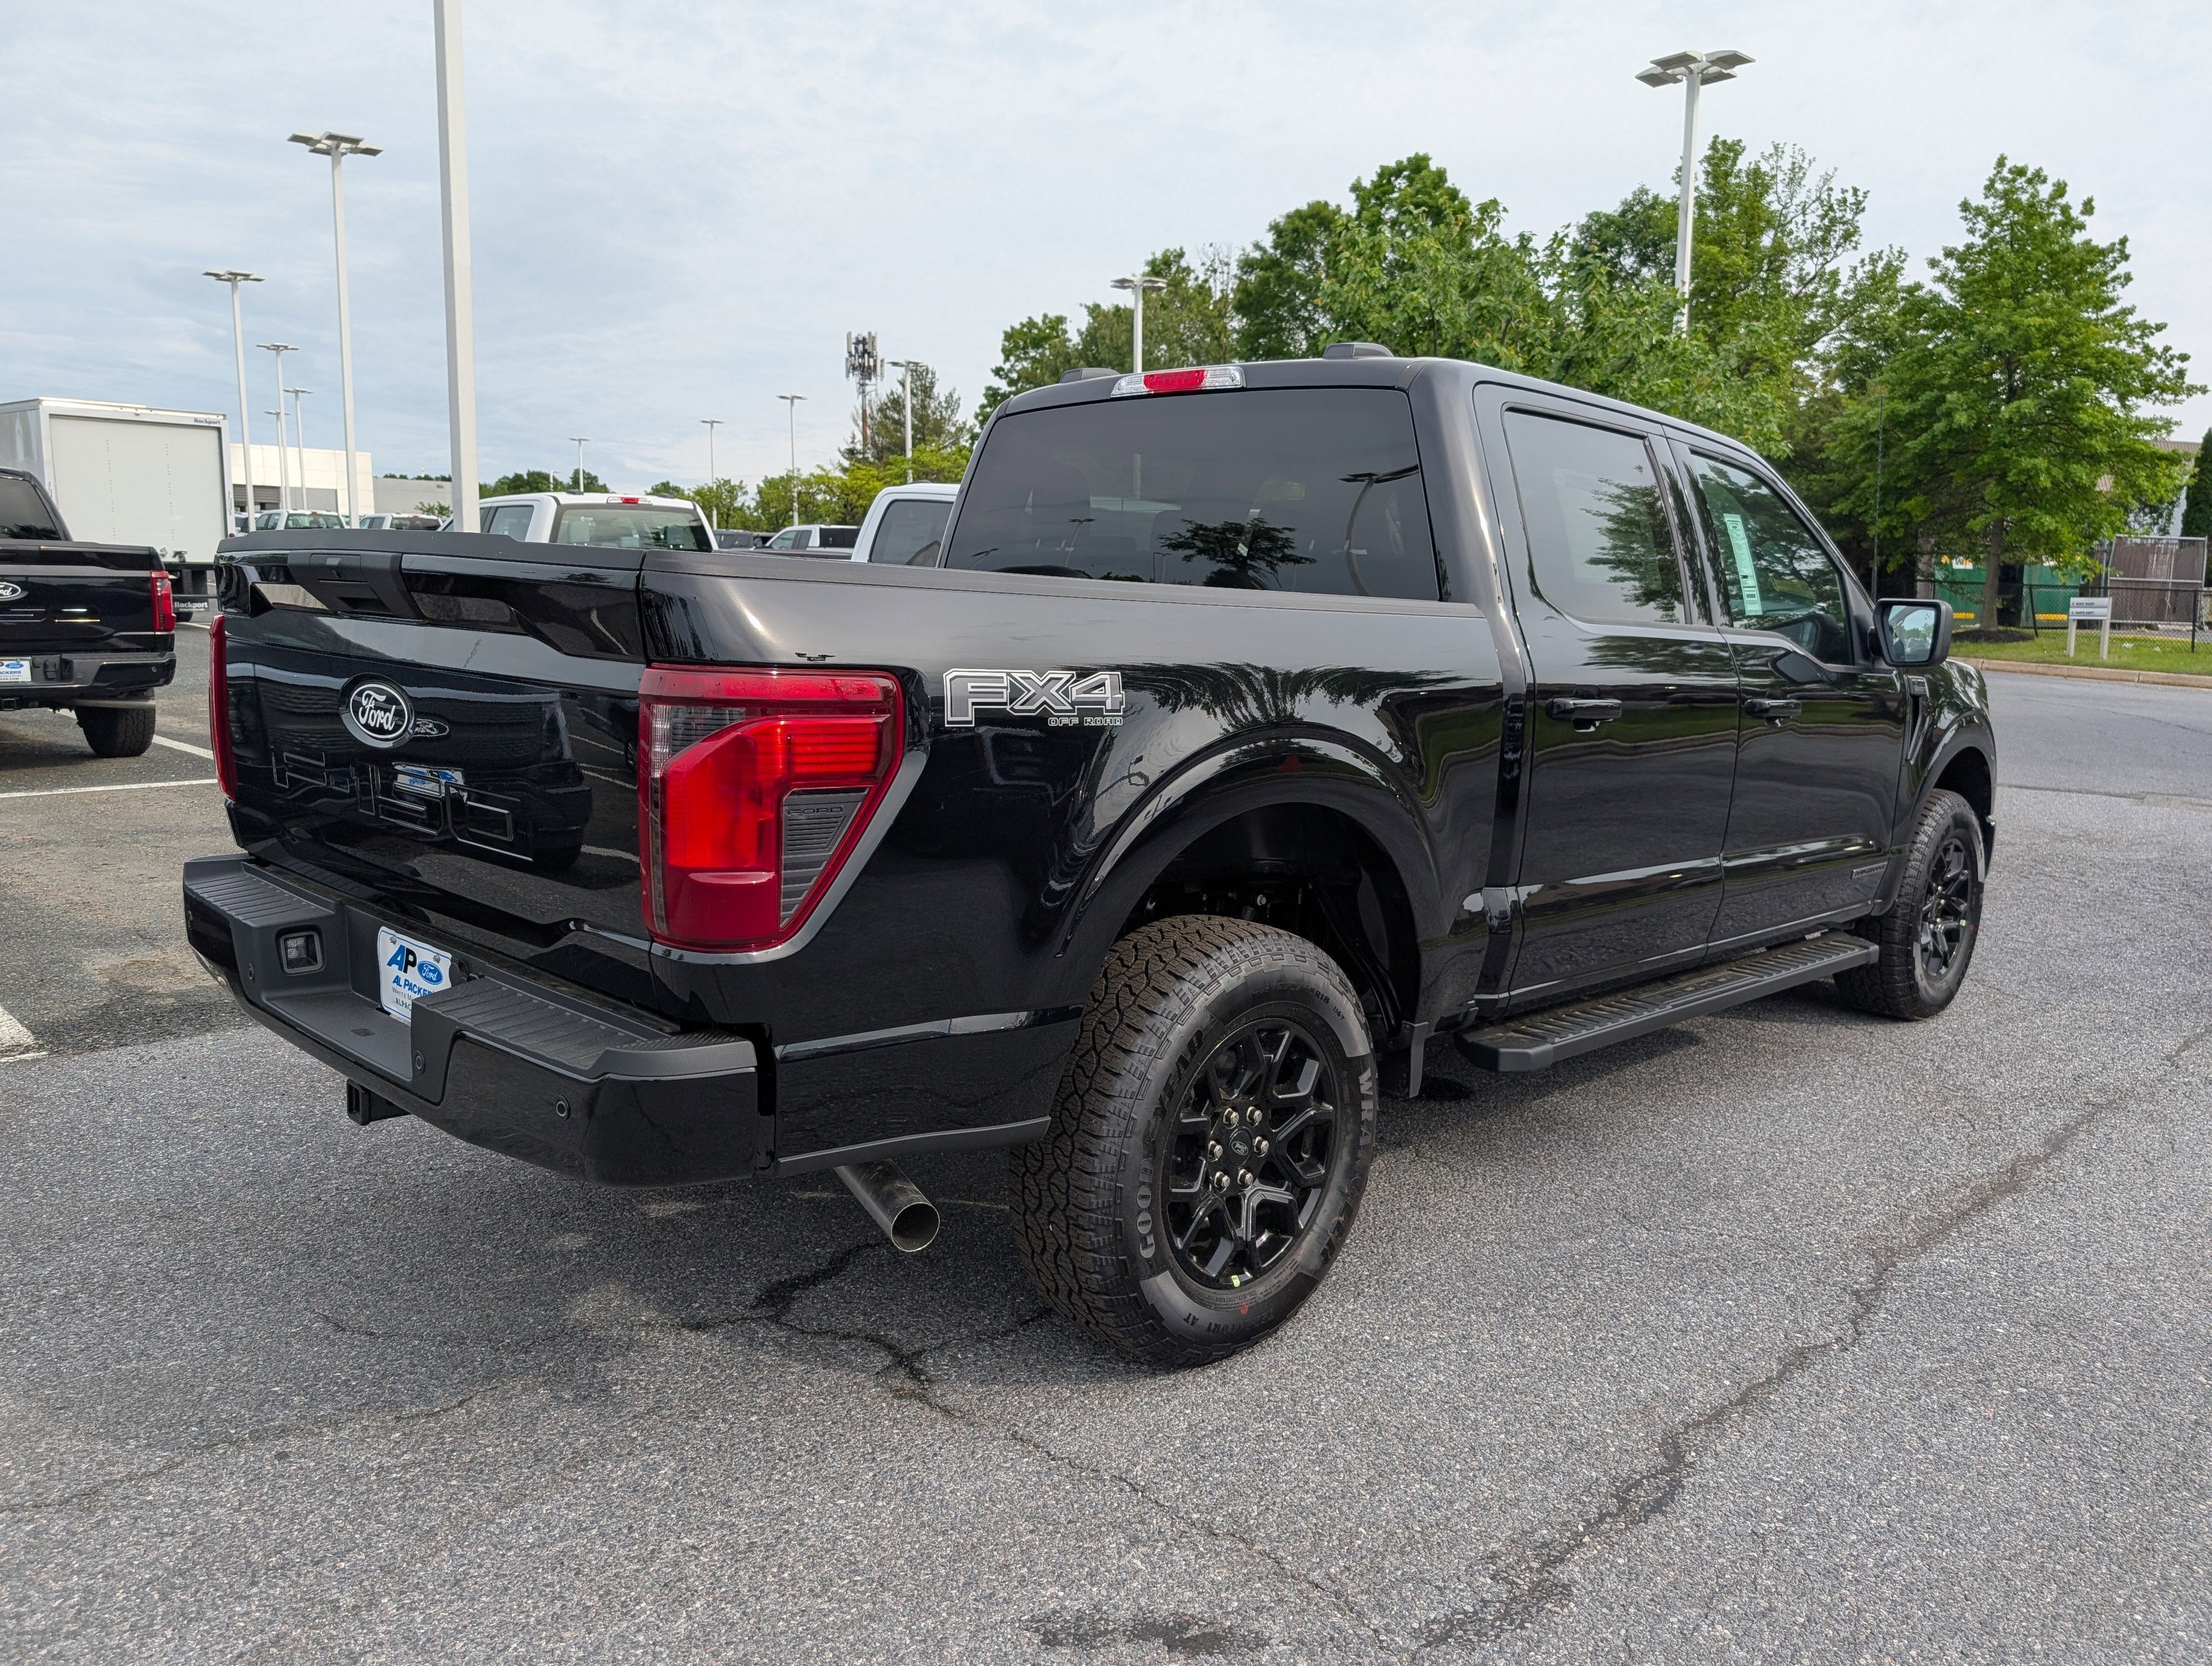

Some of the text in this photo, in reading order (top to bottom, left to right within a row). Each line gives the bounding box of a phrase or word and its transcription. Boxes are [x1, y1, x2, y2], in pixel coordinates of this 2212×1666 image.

[943, 668, 1126, 727] FX4
[359, 690, 396, 731] Ford
[1048, 716, 1123, 727] OFF ROAD
[788, 806, 843, 815] FORD
[387, 945, 417, 974] AP
[422, 964, 438, 981] Ford
[393, 975, 402, 988] AL
[391, 986, 407, 999] WHITE
[1234, 1143, 1246, 1154] Ford
